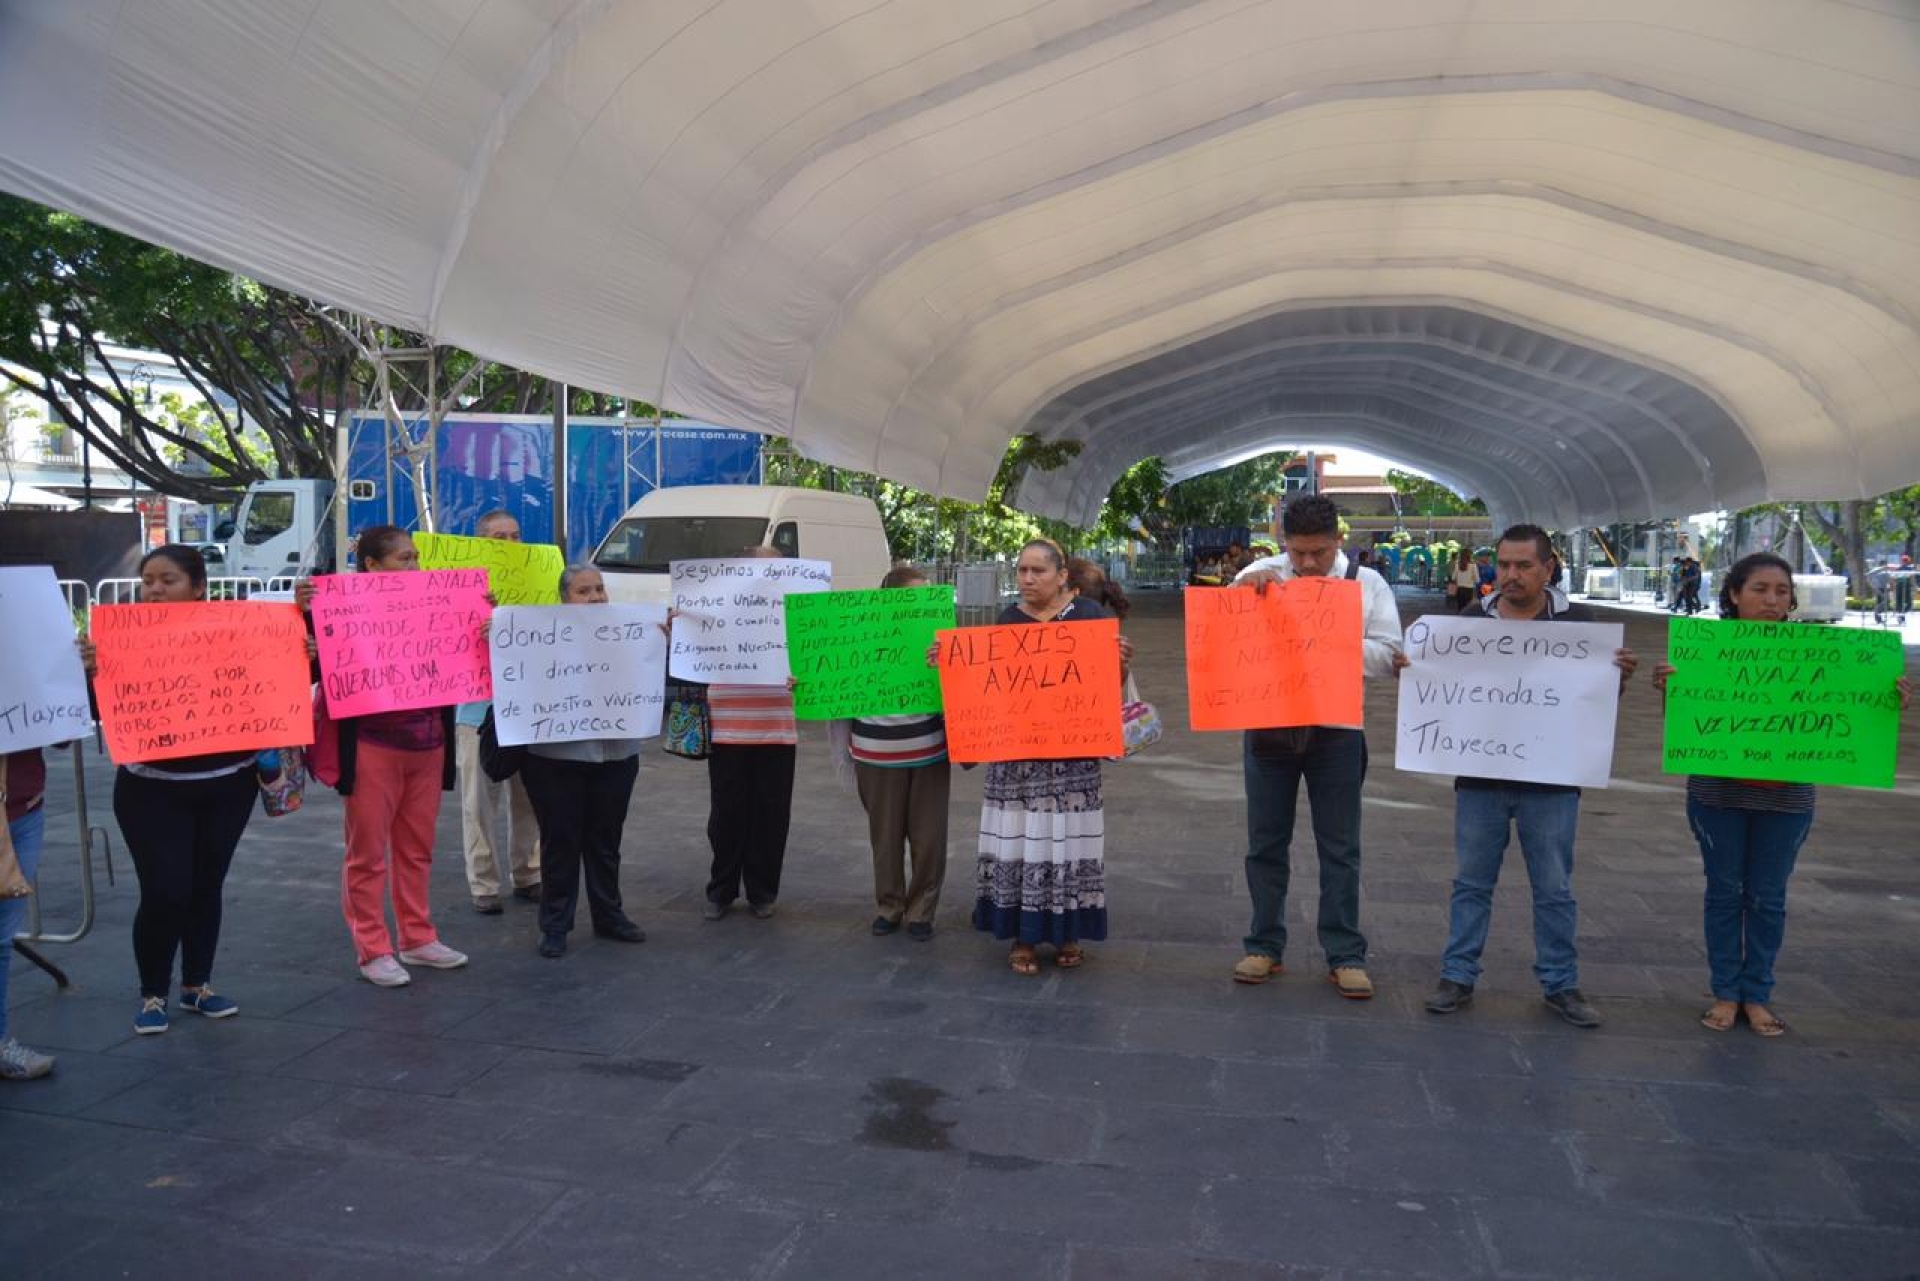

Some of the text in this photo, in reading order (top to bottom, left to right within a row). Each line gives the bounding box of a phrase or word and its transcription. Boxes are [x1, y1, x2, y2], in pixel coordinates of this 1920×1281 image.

[326, 576, 406, 595] ALEXIS
[427, 571, 484, 590] AYALA
[675, 563, 754, 583] Seguimos
[676, 593, 725, 611] Porque
[926, 587, 949, 601] DE
[429, 610, 481, 632] ESTA
[495, 612, 574, 649] donde
[701, 618, 726, 634] NO
[797, 617, 828, 634] SAN
[839, 611, 881, 628] JUAN
[1673, 620, 1716, 643] LOS
[948, 624, 1076, 668] ALEXIS
[1673, 647, 1879, 666] DEL MUNICIPIO DE
[336, 647, 360, 669] EL
[115, 665, 249, 699] UNIDOS POR
[411, 659, 440, 682] UNA
[503, 660, 610, 682] el dinero
[983, 659, 1083, 696] AYALA
[113, 693, 199, 716] MORELOS
[210, 684, 232, 700] NO
[1416, 677, 1560, 707] viviendas
[185, 709, 197, 721] A
[207, 701, 255, 717] LOS
[501, 701, 523, 718] de
[533, 694, 592, 715] nuestra
[531, 717, 628, 740] Tlayecac
[1694, 710, 1852, 739] VIVIENDAS
[1667, 748, 1857, 764] UNIDOS POR MORELOS
